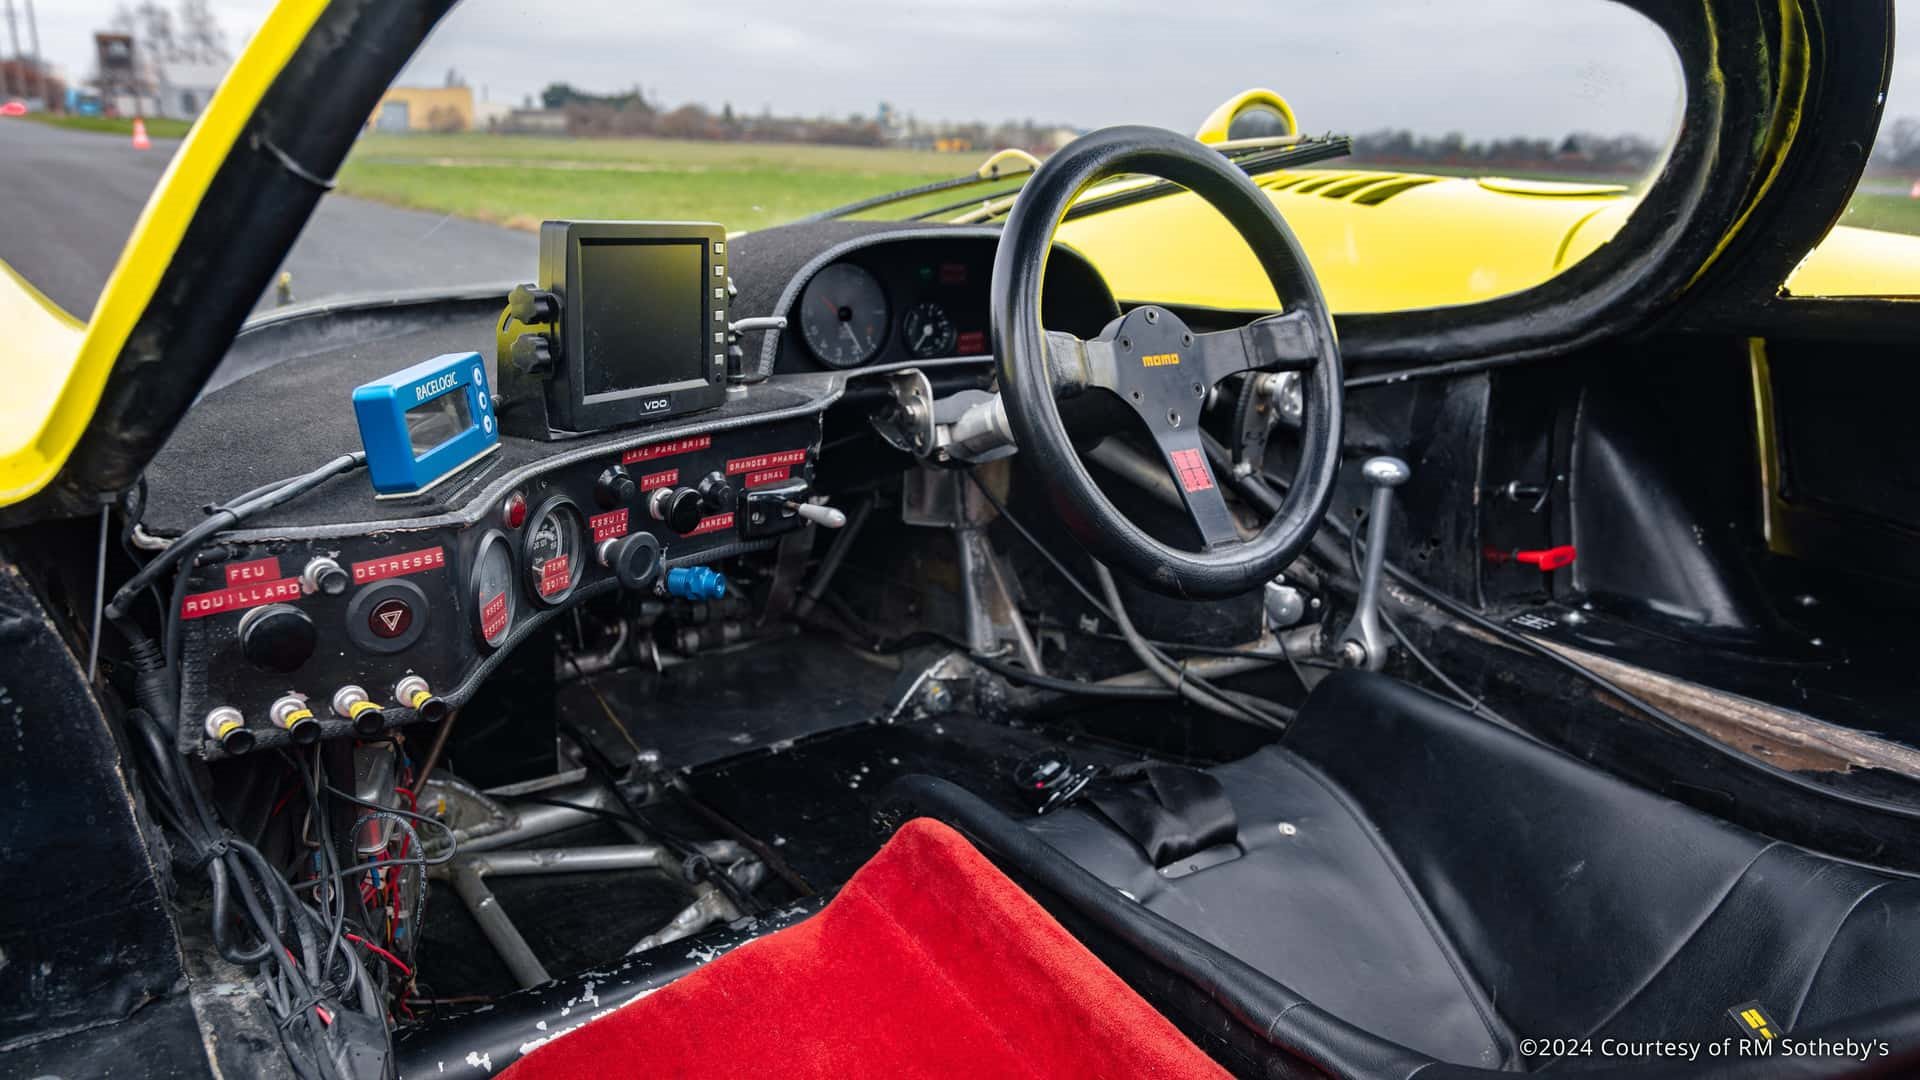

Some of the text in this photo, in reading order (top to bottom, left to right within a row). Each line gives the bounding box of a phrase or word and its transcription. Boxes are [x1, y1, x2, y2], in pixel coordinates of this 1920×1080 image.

[415, 371, 458, 401] RACELOGIC
[643, 399, 668, 410] VDO
[626, 436, 711, 460] LAVE PARE BRISE
[729, 452, 805, 472] GRANDES PHARES
[643, 472, 679, 487] PHARES
[754, 471, 784, 482] SIGNAL
[591, 512, 626, 528] ESSUIE
[598, 523, 628, 537] GLACE
[230, 565, 265, 580] FEU
[355, 552, 444, 578] DETRESSE
